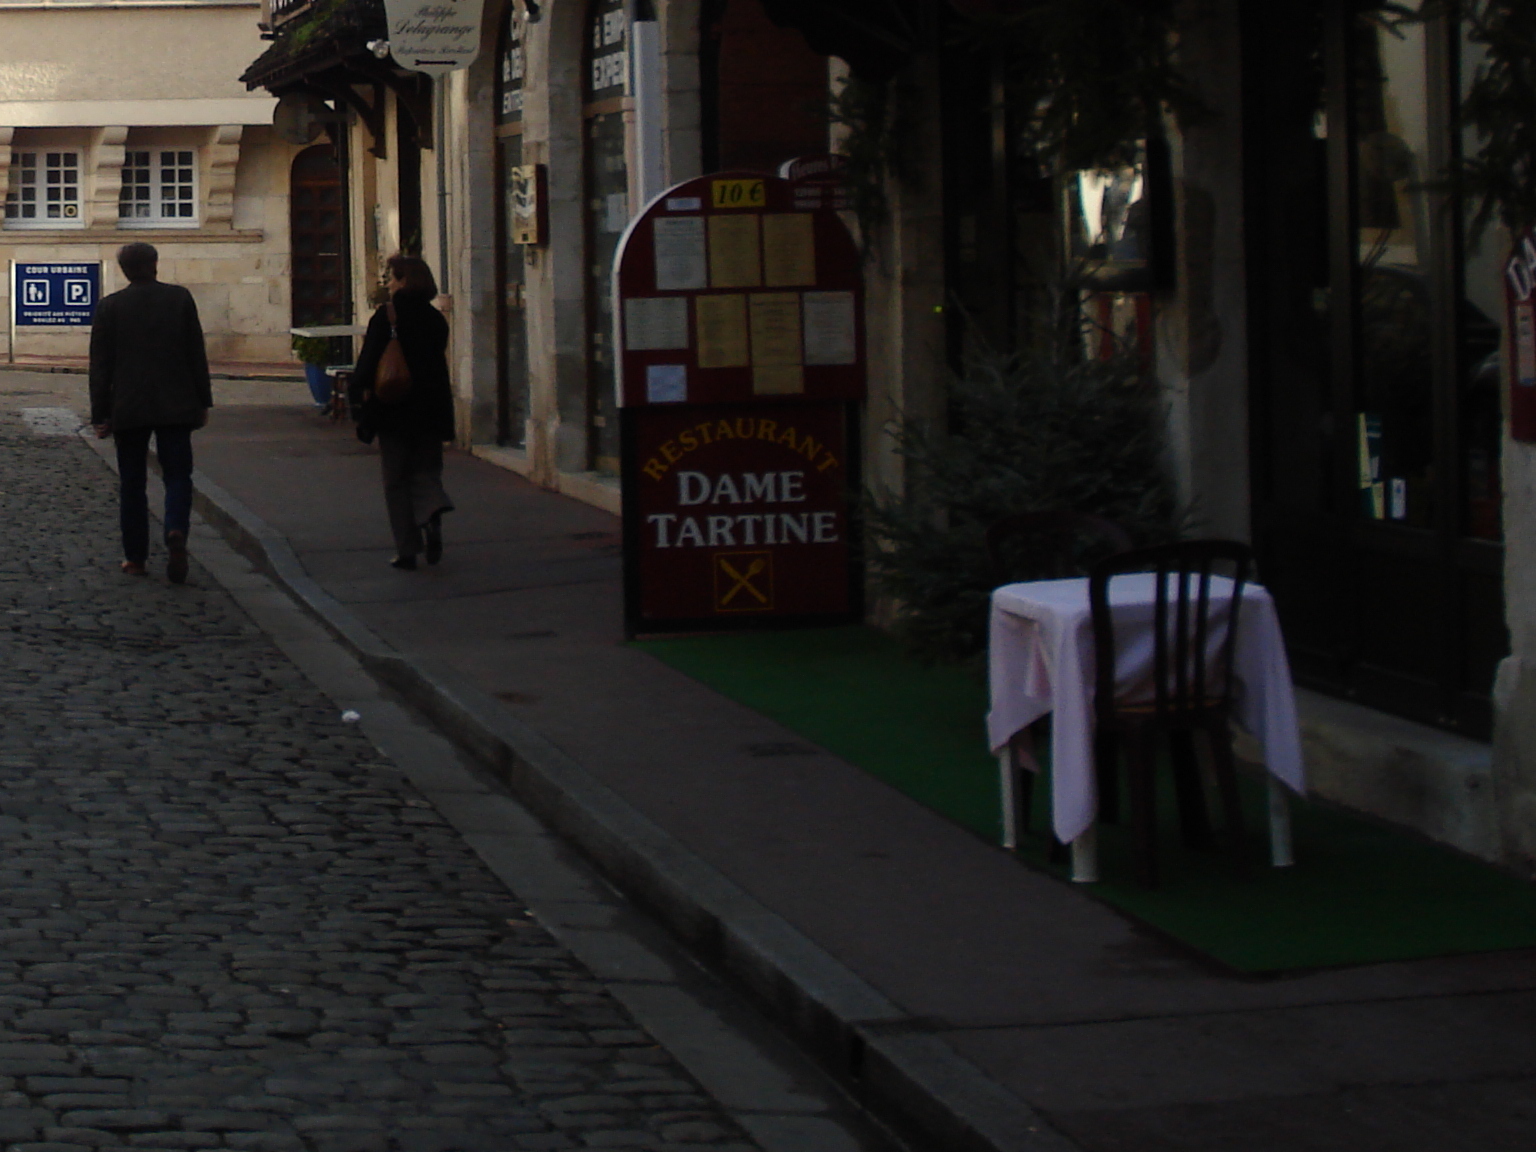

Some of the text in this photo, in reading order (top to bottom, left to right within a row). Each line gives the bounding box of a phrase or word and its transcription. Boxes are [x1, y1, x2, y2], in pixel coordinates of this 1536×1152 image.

[718, 184, 743, 204] 10
[25, 266, 88, 274] COUR URBAINE
[642, 418, 838, 481] RESTAURANT
[677, 470, 807, 506] DAME
[647, 512, 838, 548] TARTINE
